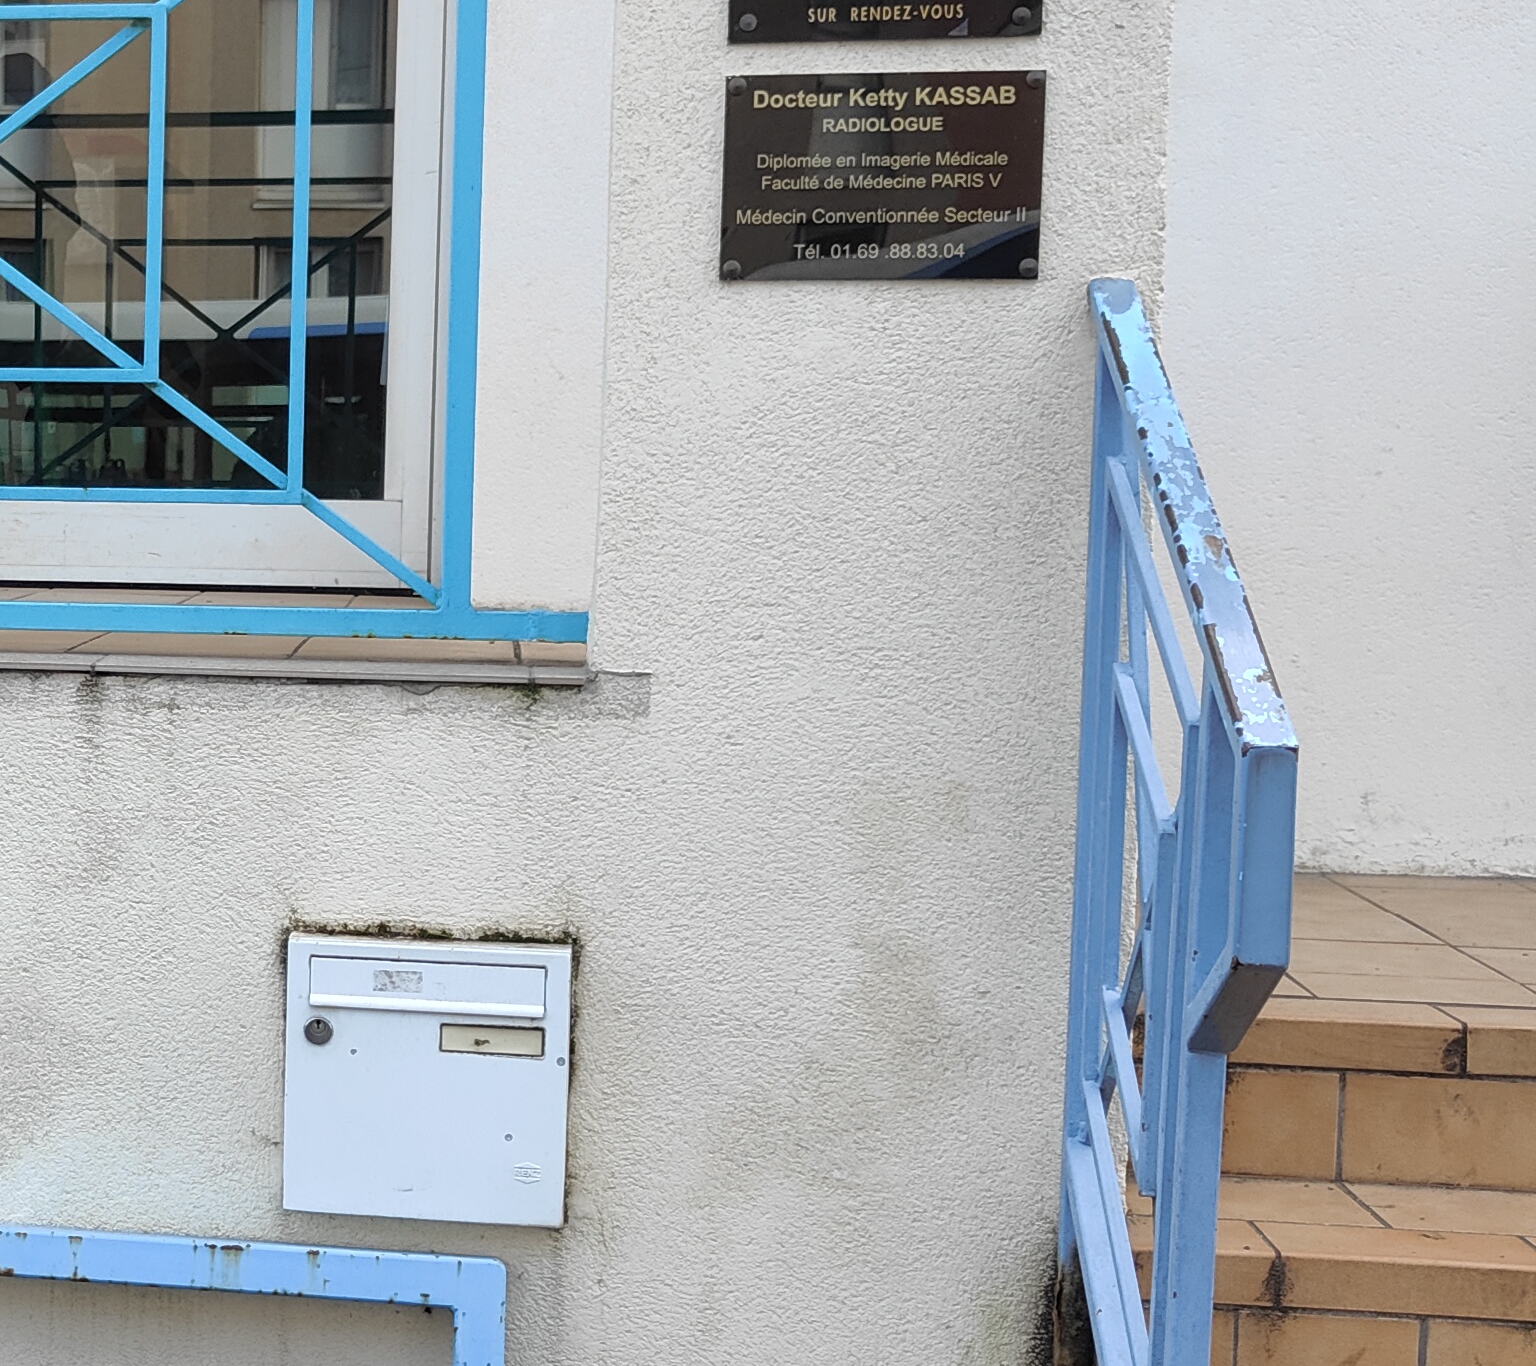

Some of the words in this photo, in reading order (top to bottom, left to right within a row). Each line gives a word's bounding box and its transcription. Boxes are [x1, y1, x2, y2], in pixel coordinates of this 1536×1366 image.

[807, 7, 837, 23] SUR
[850, 3, 964, 21] RENDEZ-VOUS
[753, 90, 842, 109] Docteur
[849, 89, 908, 111] Ketty
[915, 86, 1017, 105] KASSAB
[823, 117, 944, 133] RADIOLOGUE
[757, 154, 831, 171] Diplomée
[836, 156, 855, 167] en
[861, 153, 931, 170] Imagerie
[936, 151, 1008, 167] Médicale
[762, 175, 819, 191] Faculté
[824, 176, 843, 189] de
[849, 175, 926, 189] Médecine
[932, 173, 984, 187] PARIS
[988, 173, 1002, 187] V
[736, 210, 807, 225] Médecin
[812, 208, 939, 224] Conventionnée
[944, 207, 1011, 223] Secteur
[1015, 207, 1026, 221] II
[794, 243, 824, 260] Tél.
[831, 243, 879, 259] 01.69
